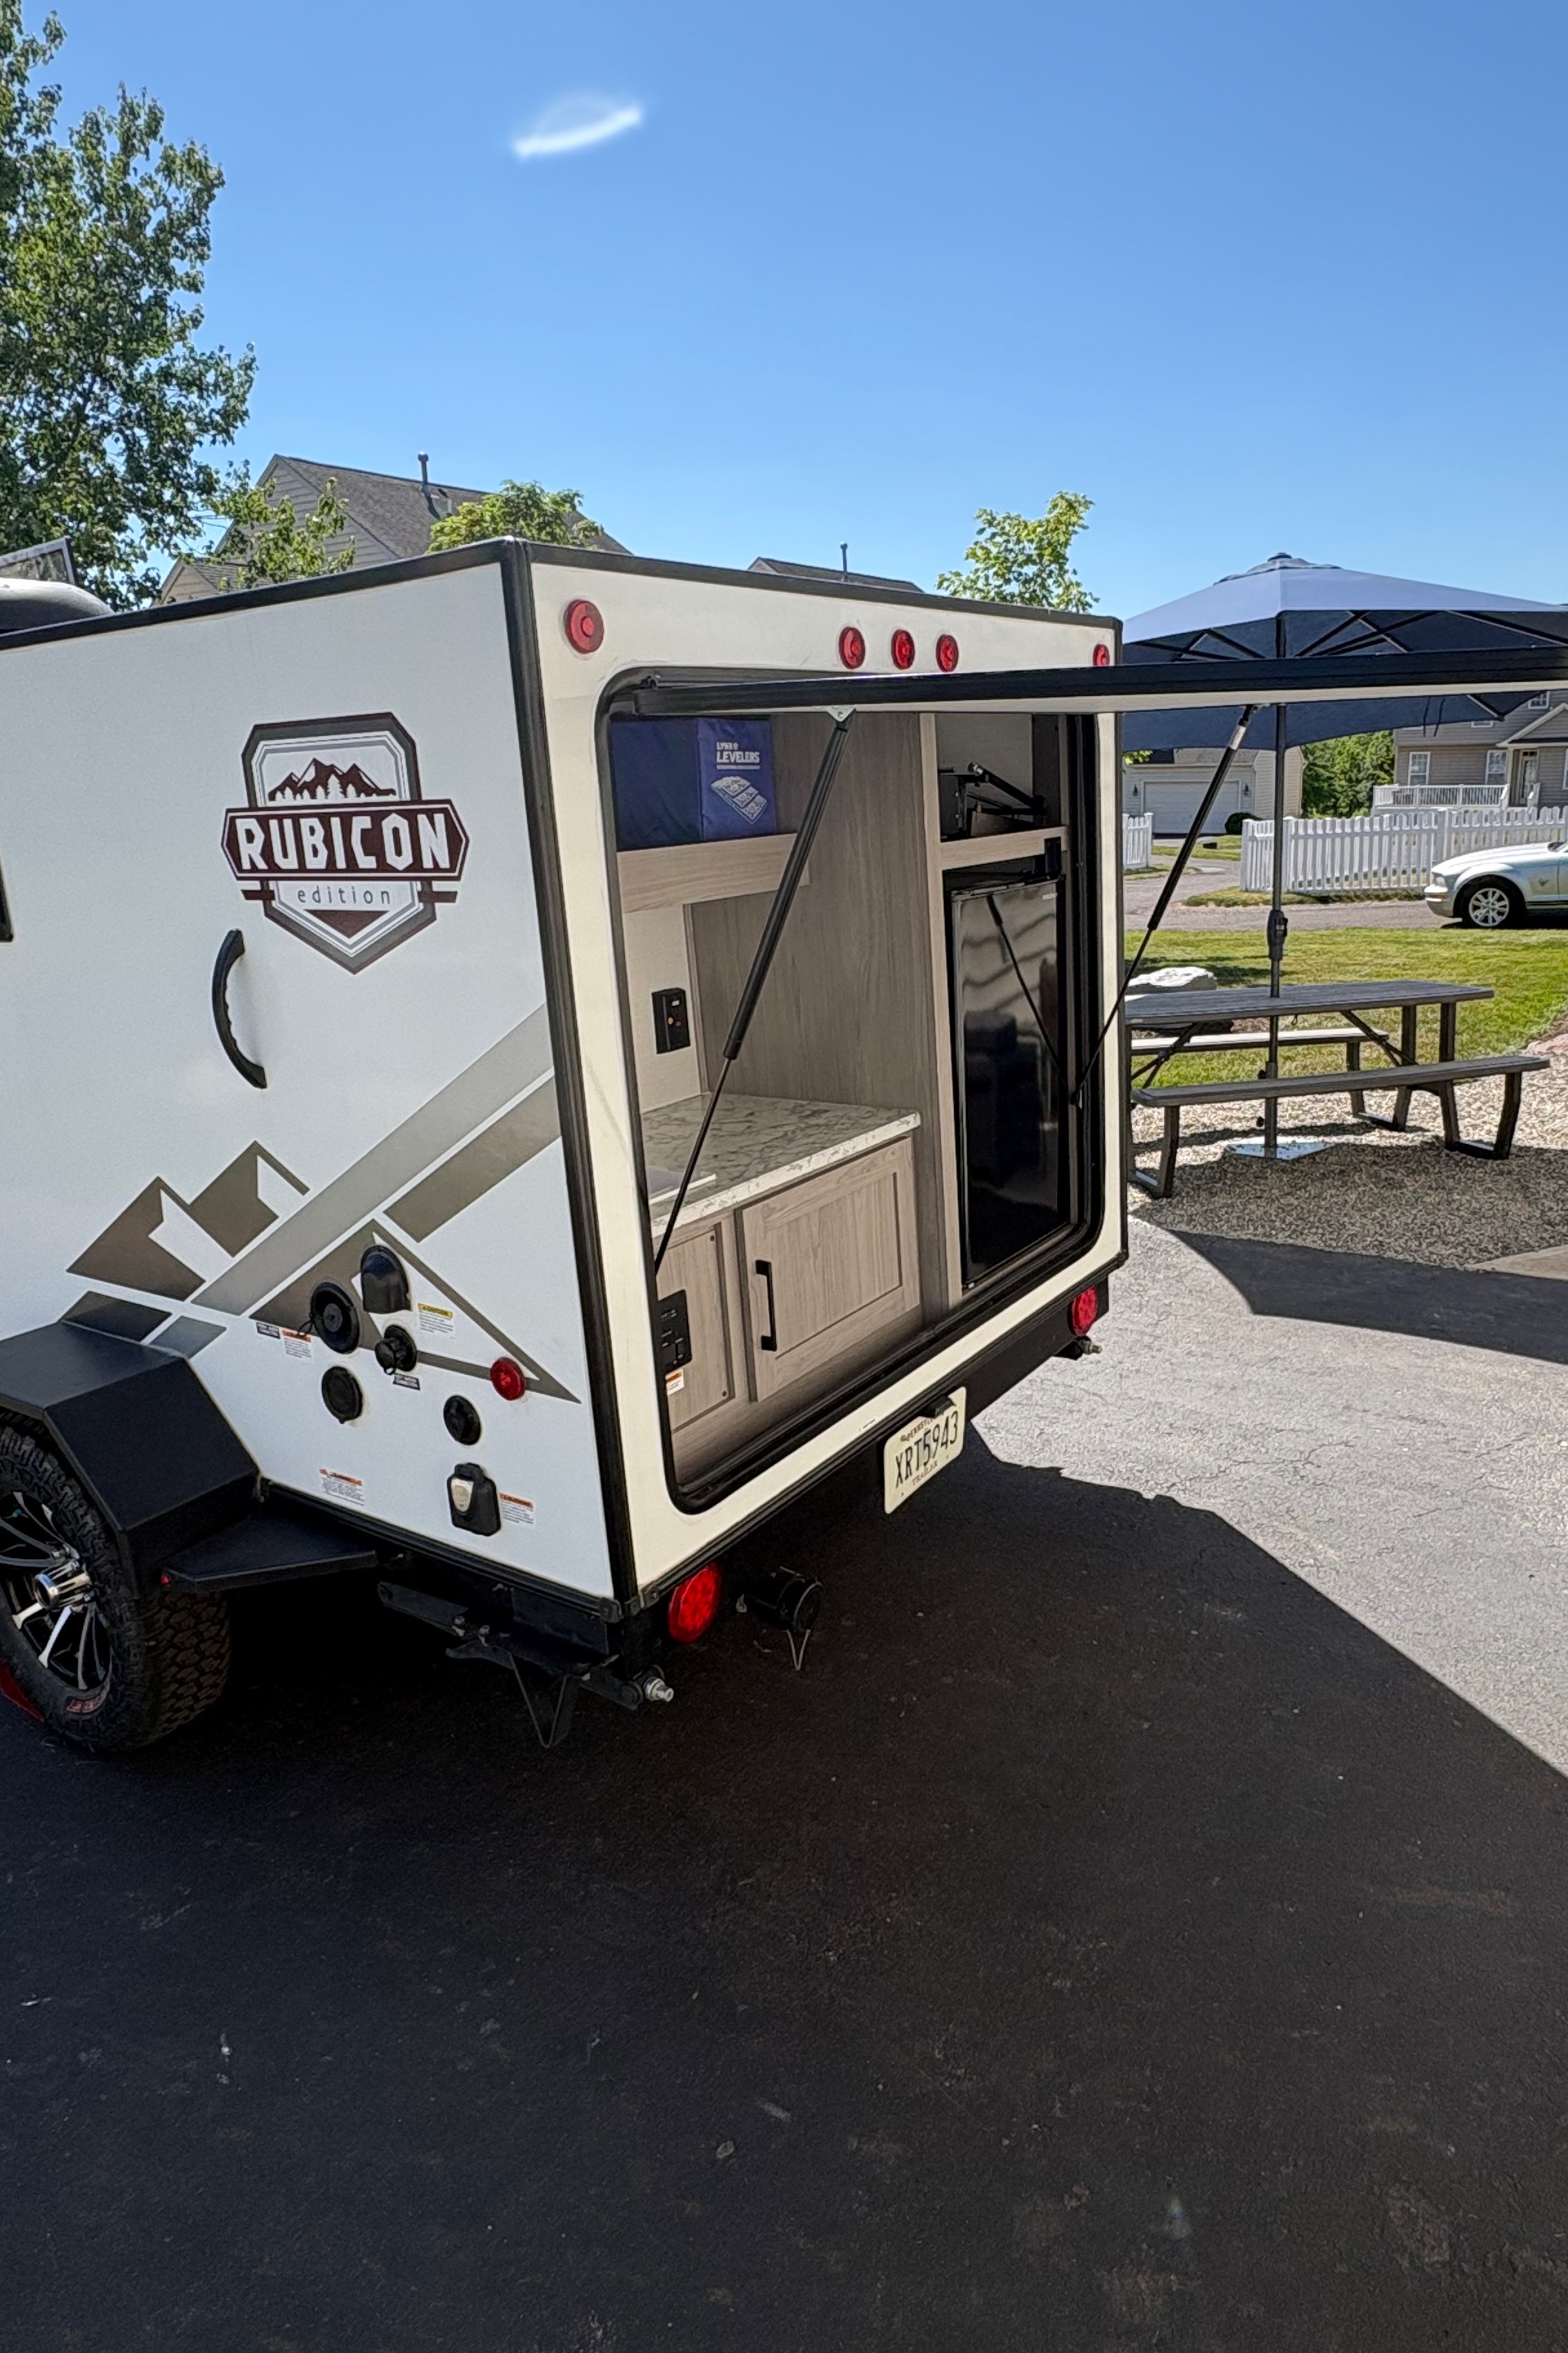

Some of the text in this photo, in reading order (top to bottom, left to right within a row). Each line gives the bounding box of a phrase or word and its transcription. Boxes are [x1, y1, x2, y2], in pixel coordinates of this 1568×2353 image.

[717, 751, 760, 763] LEVELERS
[235, 812, 451, 871] RUBICON
[297, 885, 391, 905] edition
[895, 1410, 958, 1488] XRT5943
